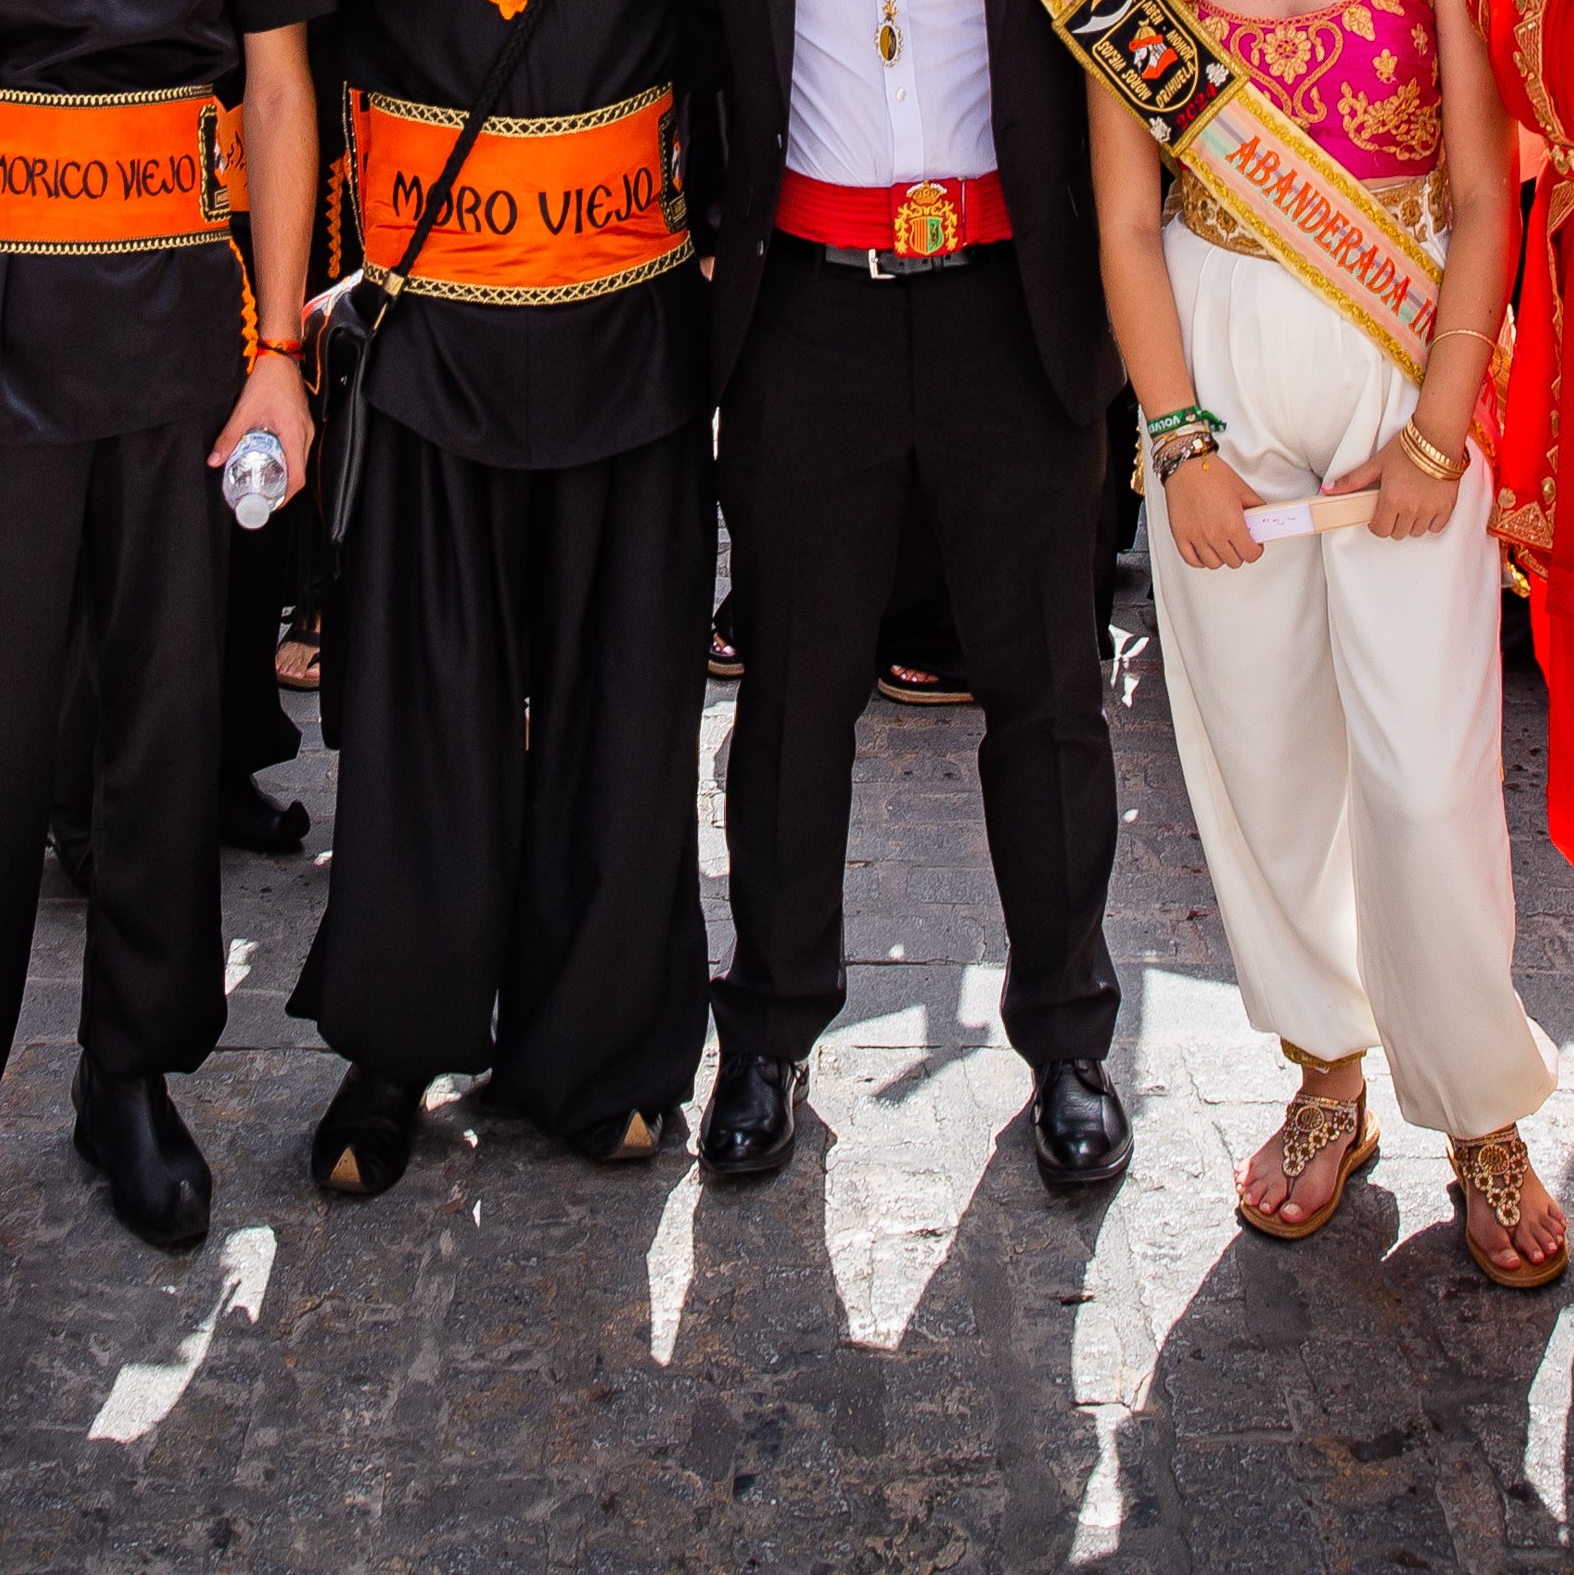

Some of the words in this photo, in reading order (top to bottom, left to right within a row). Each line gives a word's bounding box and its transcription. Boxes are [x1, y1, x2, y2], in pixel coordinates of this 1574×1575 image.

[1141, 0, 1165, 26] ABEN
[1097, 40, 1127, 73] VIEJOS
[1122, 68, 1153, 102] MOROS
[1155, 61, 1197, 109] ORIHUELA
[1176, 81, 1217, 132] 2024
[116, 153, 197, 201] VIEJO
[538, 167, 654, 236] VIEJO
[1226, 134, 1412, 317] ABANDERADA
